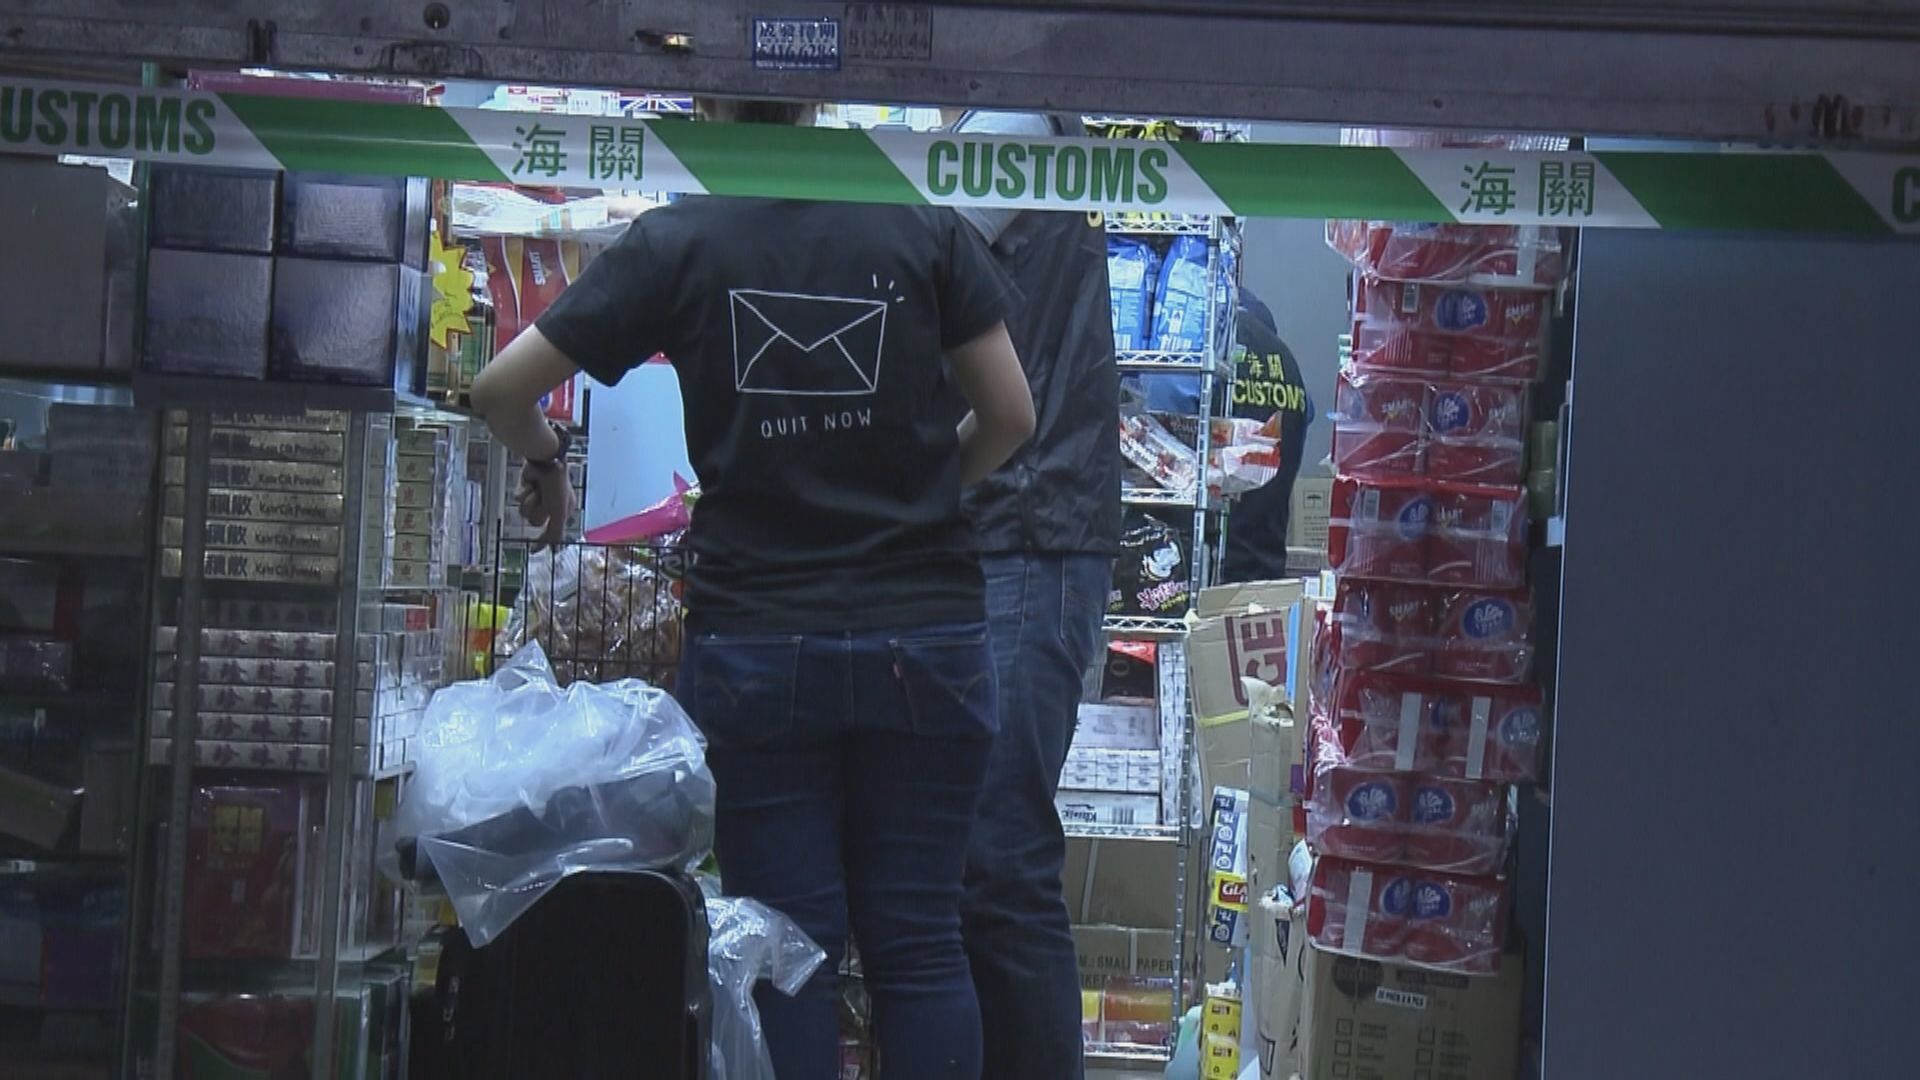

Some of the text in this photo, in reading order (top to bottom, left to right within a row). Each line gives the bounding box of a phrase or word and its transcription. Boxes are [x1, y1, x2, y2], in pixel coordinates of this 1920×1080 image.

[512, 122, 644, 181] 海關
[927, 140, 1168, 204] CUSTOMS
[1460, 160, 1595, 217] 海關
[761, 407, 871, 439] QUIT NOW
[1232, 379, 1306, 413] CUSTOMS
